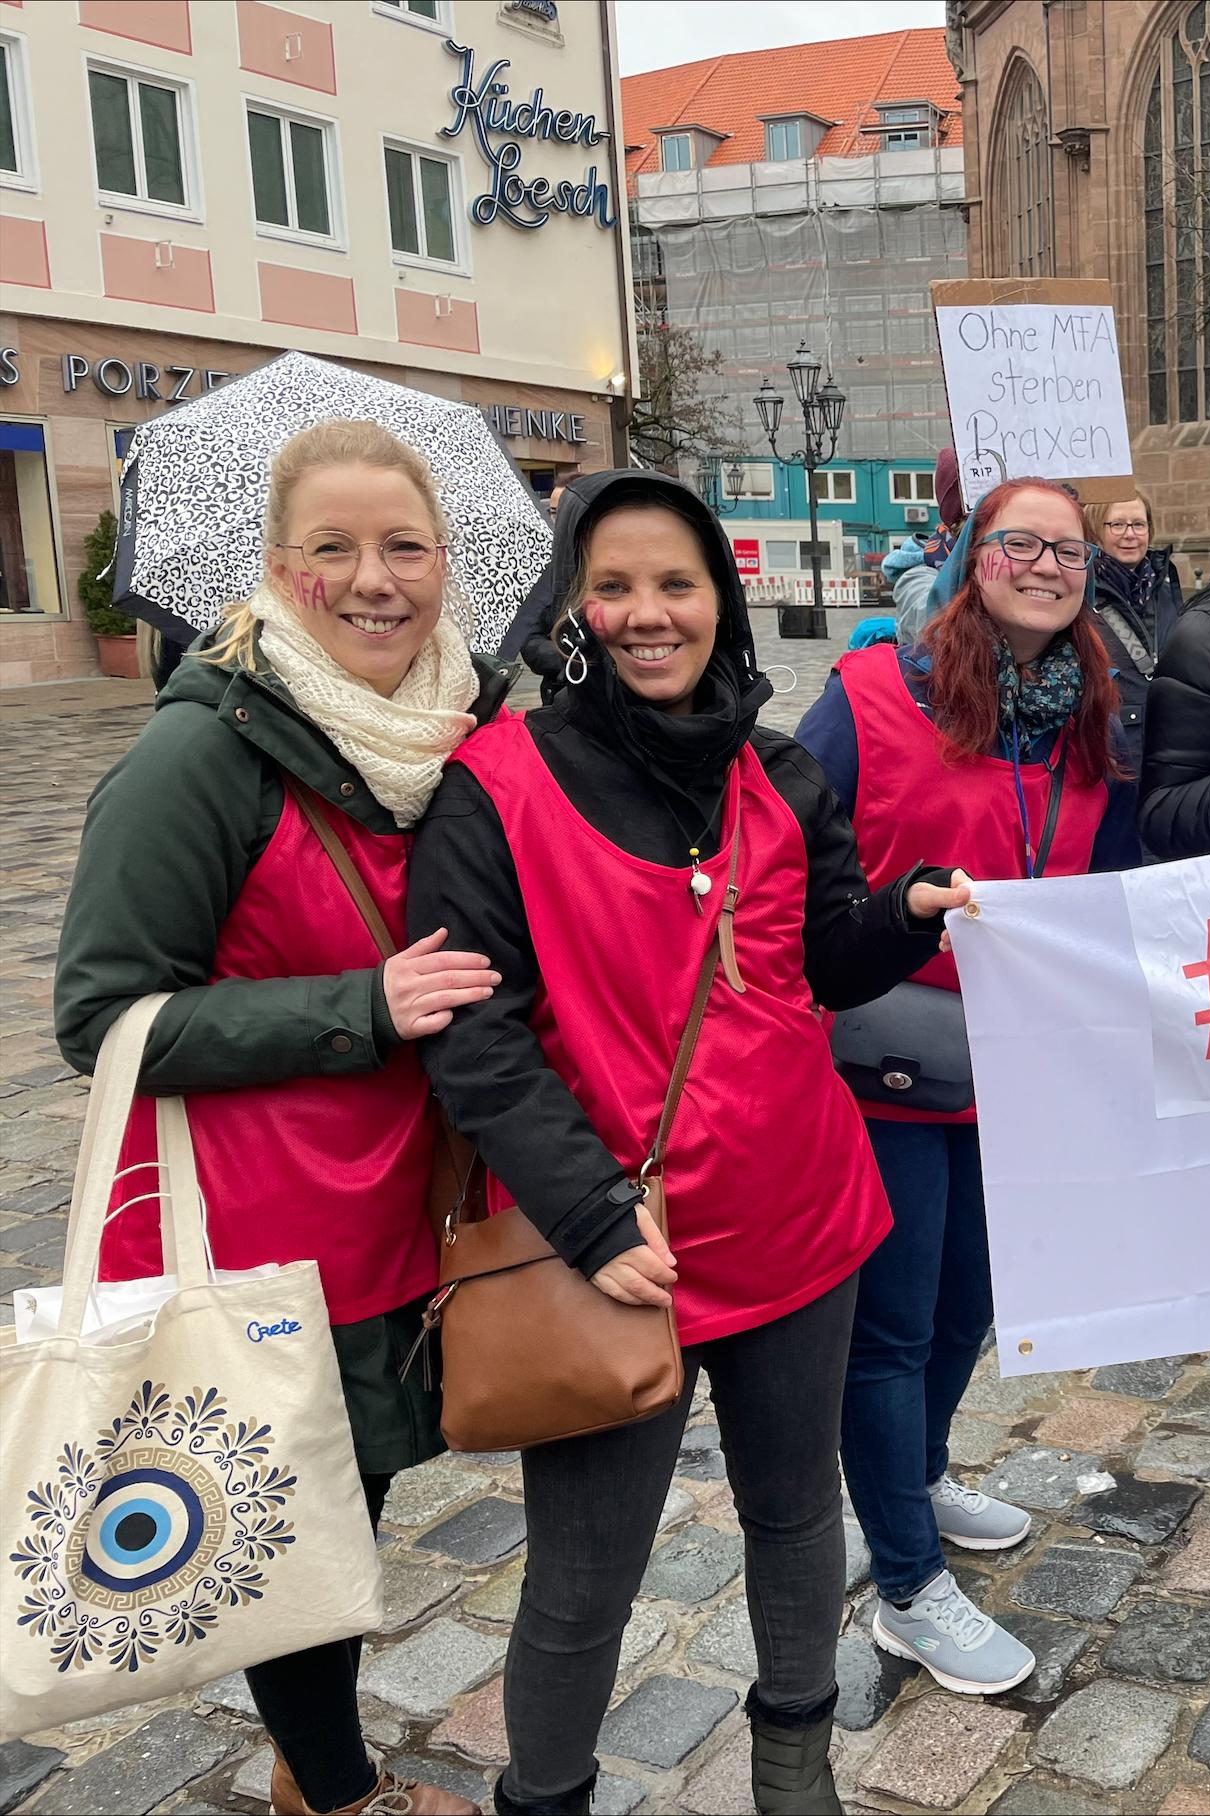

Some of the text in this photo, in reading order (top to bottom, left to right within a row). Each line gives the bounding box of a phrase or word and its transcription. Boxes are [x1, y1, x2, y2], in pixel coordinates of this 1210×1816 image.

[438, 40, 611, 164] Küchen-
[470, 141, 617, 230] Loesch
[958, 309, 1115, 354] Ohne MFA
[988, 354, 1102, 405] sterben
[966, 409, 1112, 463] Praxen
[970, 467, 992, 477] RIP
[980, 549, 1014, 585] MFA
[247, 1318, 302, 1343] Crete
